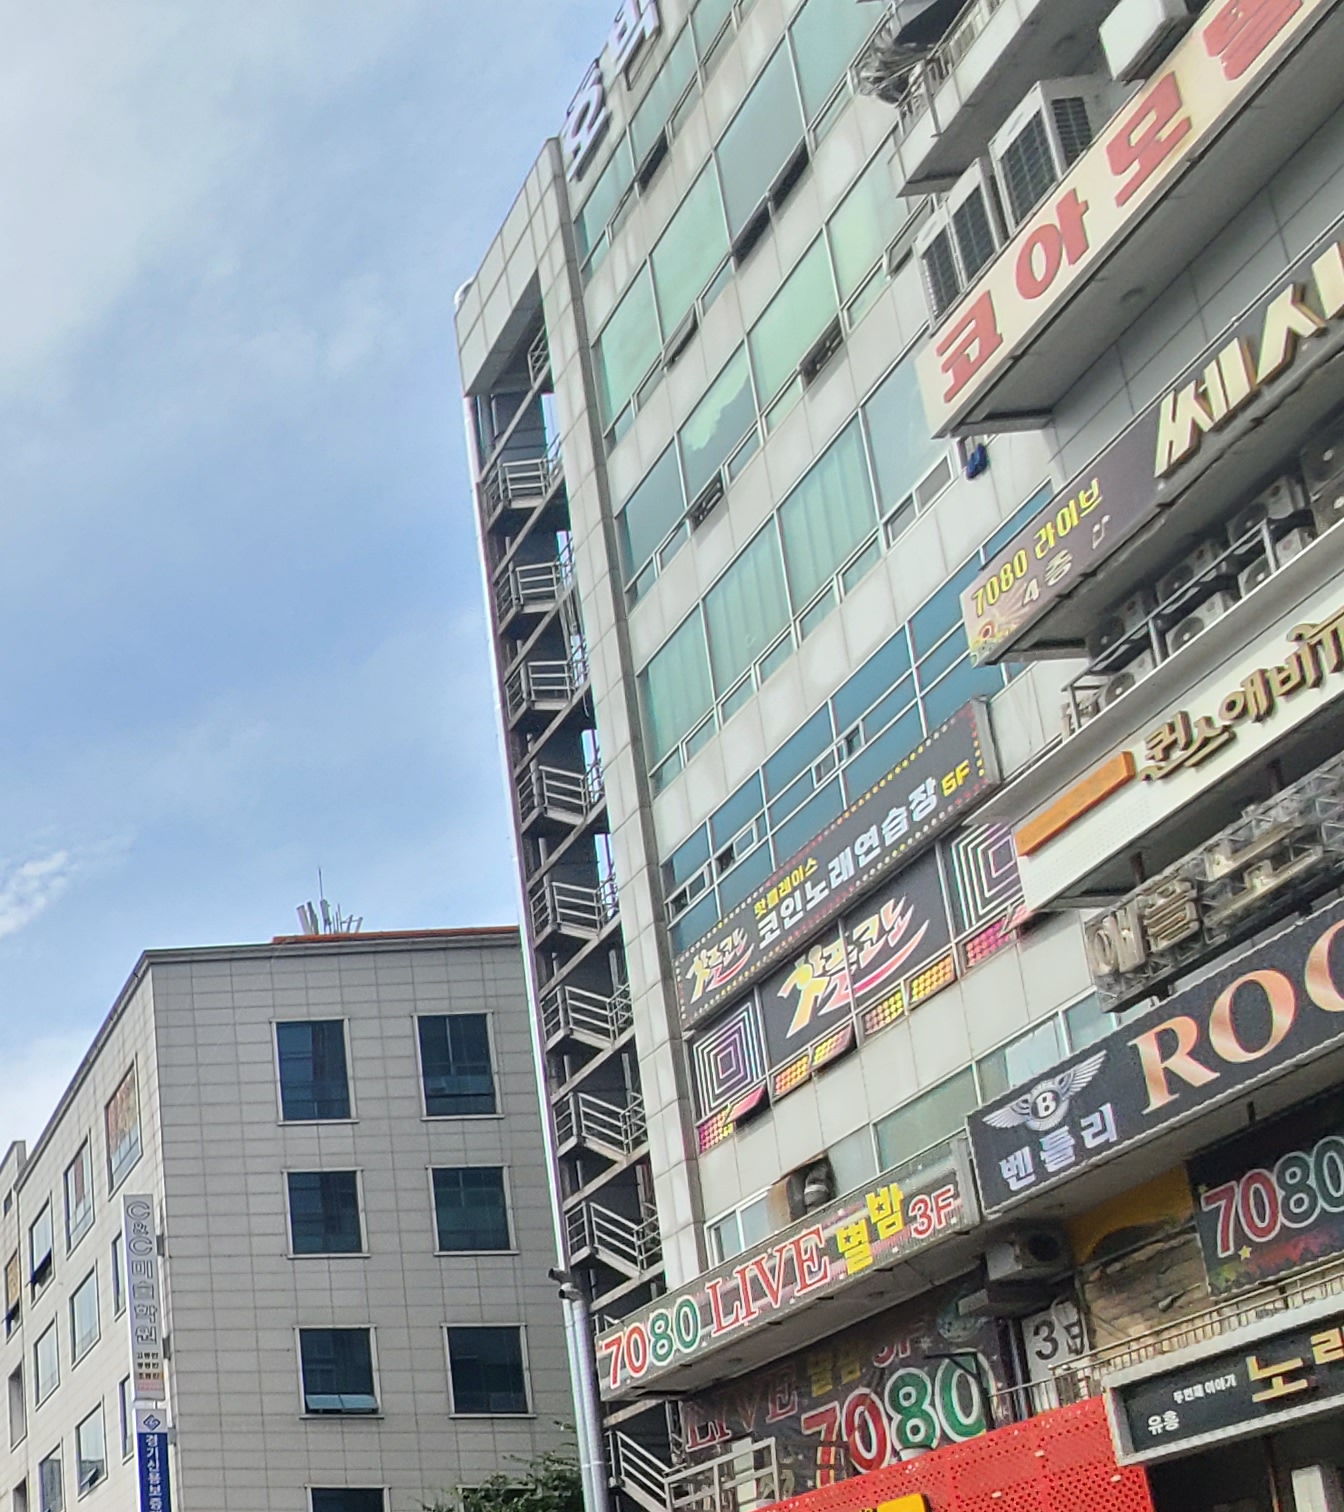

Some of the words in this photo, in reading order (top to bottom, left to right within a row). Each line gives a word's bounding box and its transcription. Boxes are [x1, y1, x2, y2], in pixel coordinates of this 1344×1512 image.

[971, 549, 1029, 618] 7080
[1032, 476, 1103, 560] 라이브
[757, 777, 937, 948] 코인노래연습장
[999, 1103, 1117, 1191] 벤틀리
[601, 1295, 700, 1389] 7080
[707, 1225, 831, 1339] LIVE
[837, 1183, 904, 1275] 별밤
[909, 1184, 954, 1237] 3F
[801, 1347, 995, 1474] 7080
[1148, 1411, 1180, 1435] 유흥
